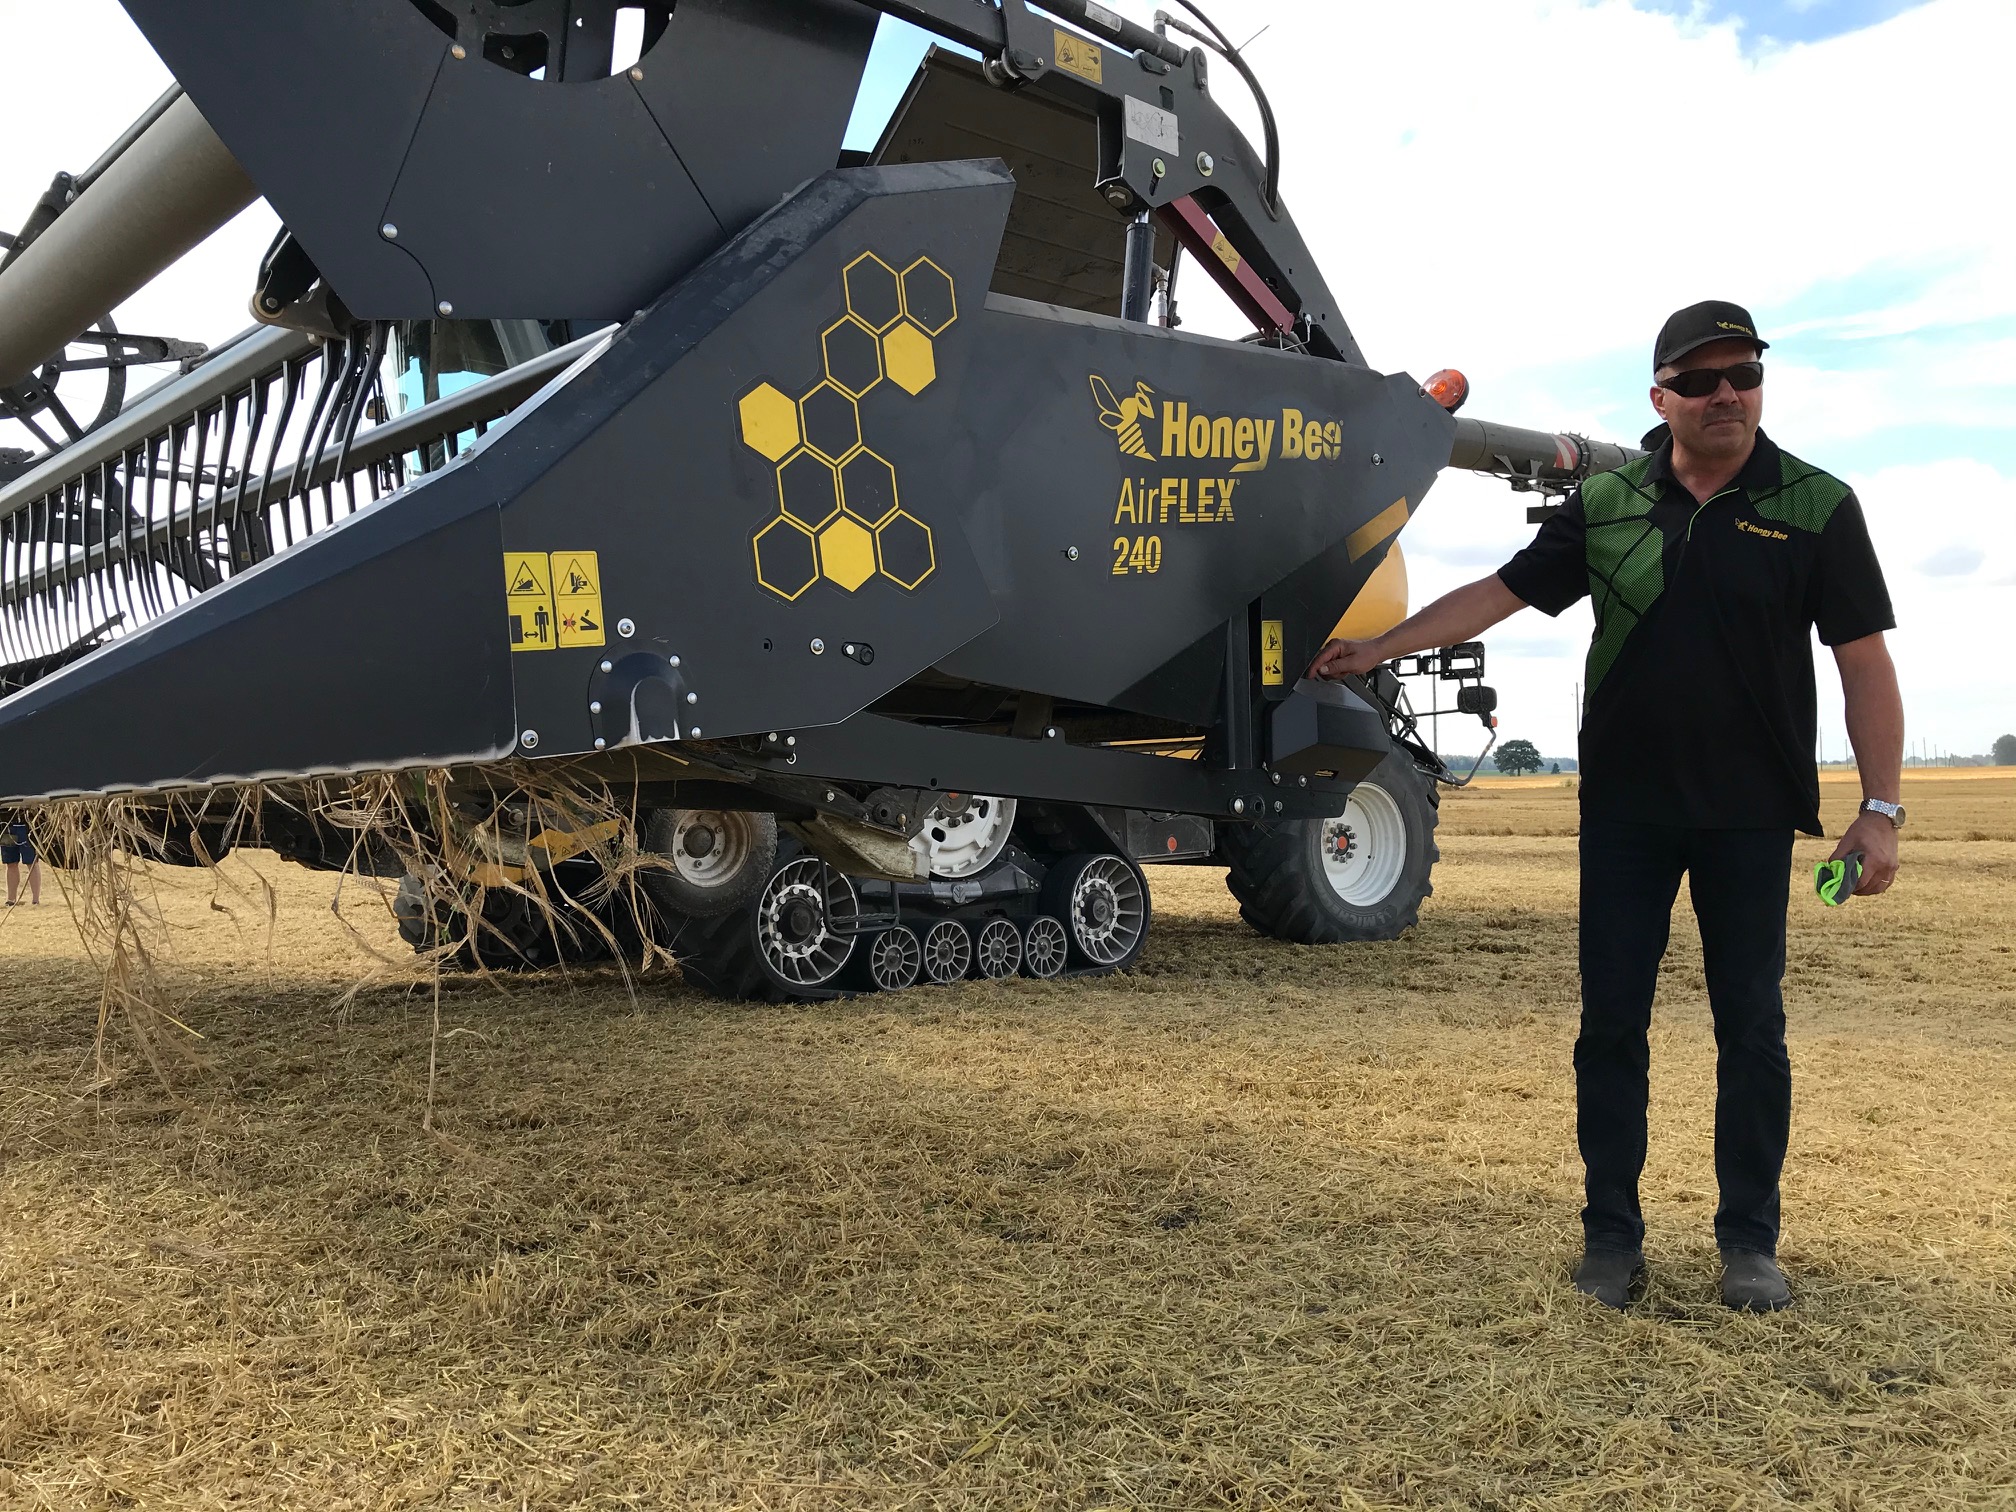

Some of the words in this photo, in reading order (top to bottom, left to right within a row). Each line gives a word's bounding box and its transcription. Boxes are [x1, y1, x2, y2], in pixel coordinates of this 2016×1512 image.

[1161, 401, 1275, 473] Honey
[1279, 408, 1342, 461] Bee
[1114, 477, 1236, 525] AirFLEX
[1747, 524, 1773, 538] Honey
[1771, 530, 1788, 541] Bee
[1112, 535, 1163, 575] 240
